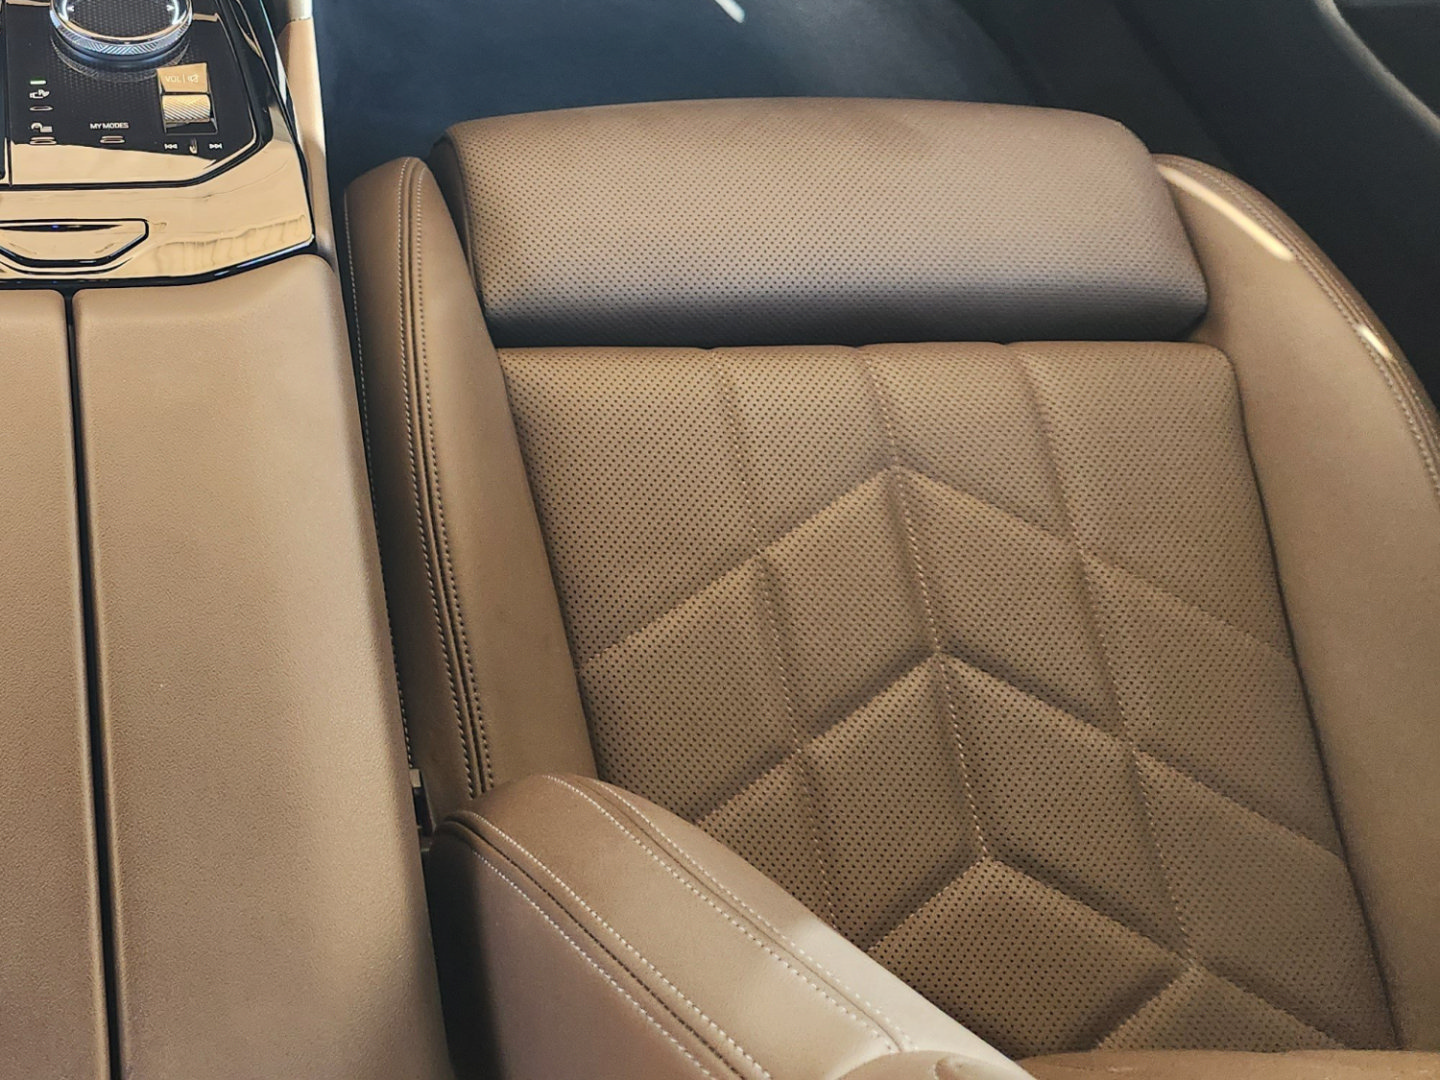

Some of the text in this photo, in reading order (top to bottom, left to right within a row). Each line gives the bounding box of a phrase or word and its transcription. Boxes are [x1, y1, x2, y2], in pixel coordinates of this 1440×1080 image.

[164, 74, 180, 84] VOL
[89, 122, 130, 130] MY MODES
